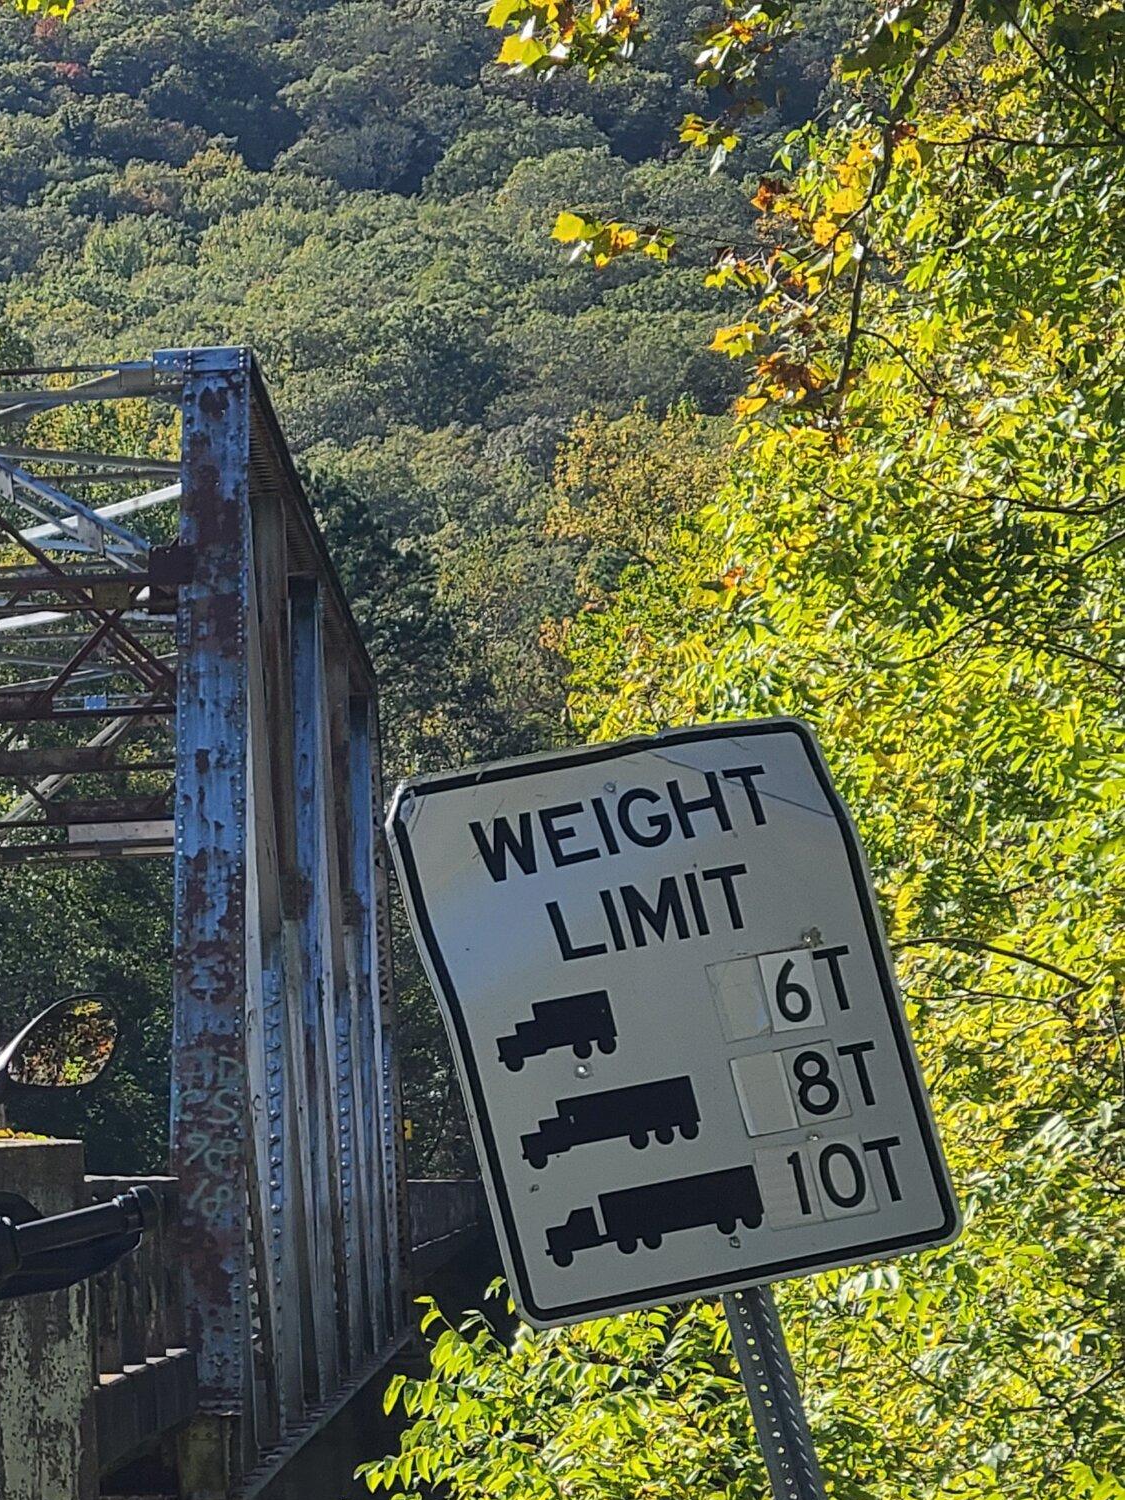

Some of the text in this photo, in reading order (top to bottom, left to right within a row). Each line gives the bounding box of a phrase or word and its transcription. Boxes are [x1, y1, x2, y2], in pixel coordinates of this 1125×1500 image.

[468, 764, 768, 883] WEIGHT
[545, 863, 748, 961] LIMIT
[775, 945, 851, 1023] 6T
[793, 1040, 876, 1115] 8T
[786, 1135, 904, 1216] 10T
